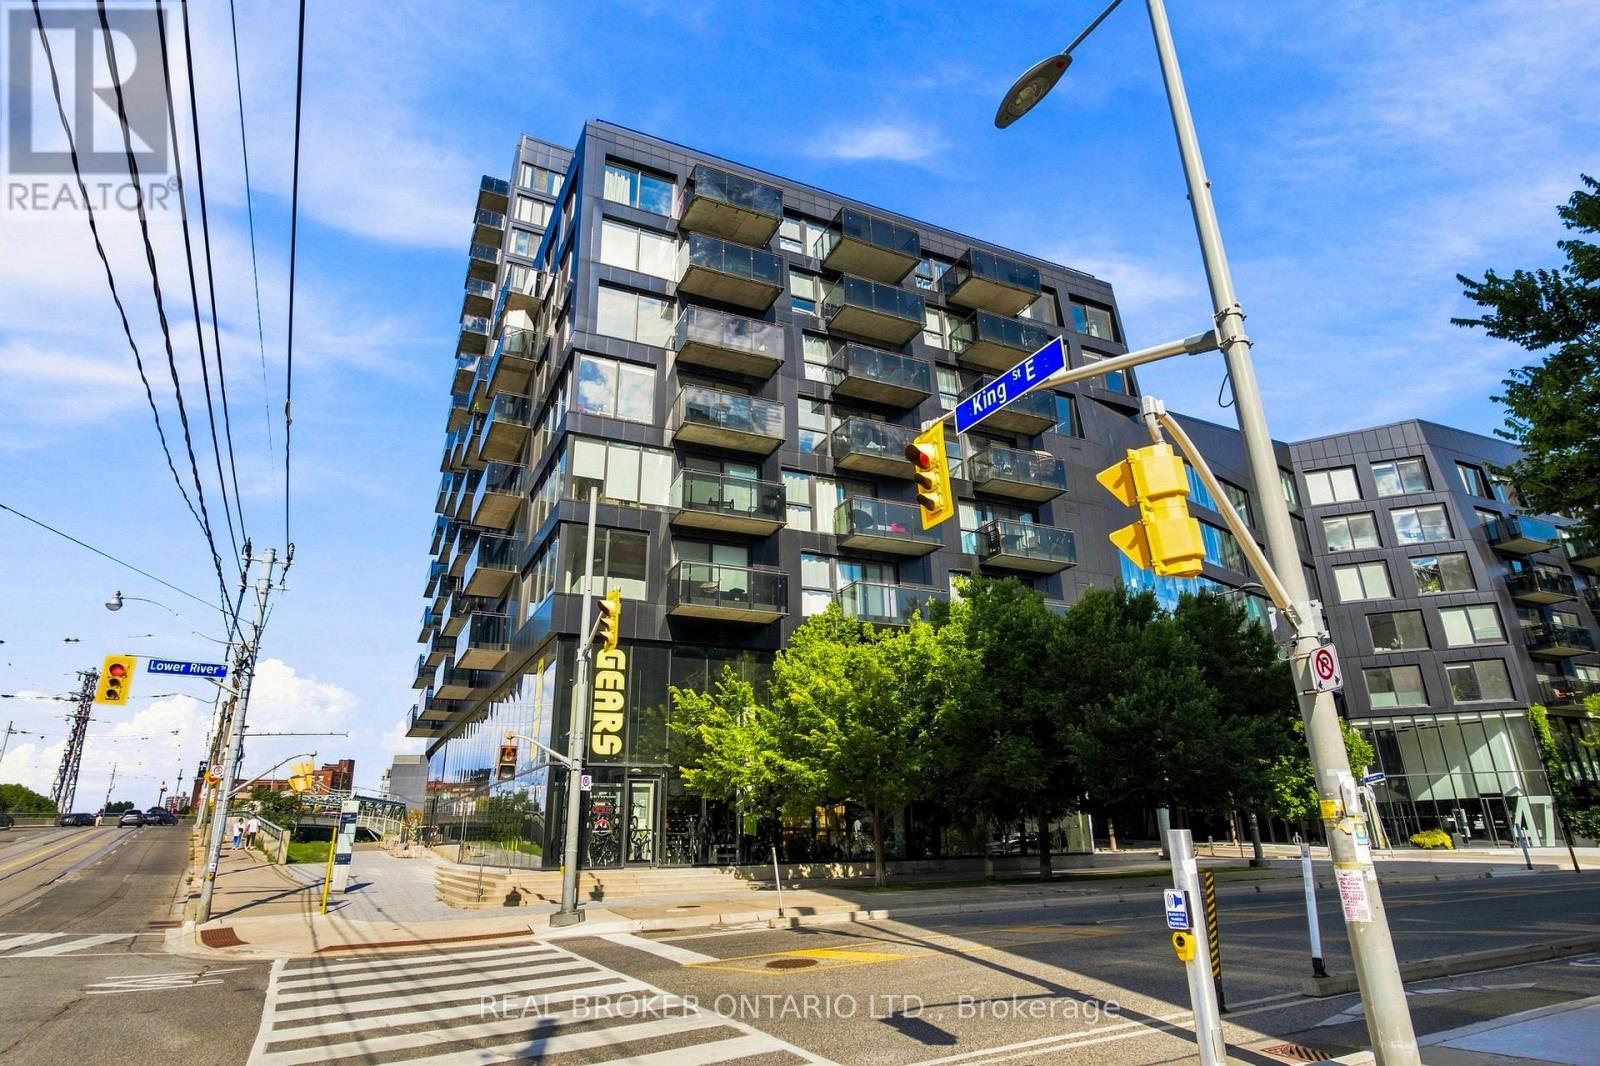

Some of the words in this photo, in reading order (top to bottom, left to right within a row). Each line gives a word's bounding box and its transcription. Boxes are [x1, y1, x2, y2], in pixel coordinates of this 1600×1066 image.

[972, 382, 1007, 415] King
[1012, 368, 1021, 381] St
[1025, 358, 1036, 381] E
[150, 660, 186, 672] Lower
[189, 663, 219, 674] River
[592, 648, 626, 756] GEARS
